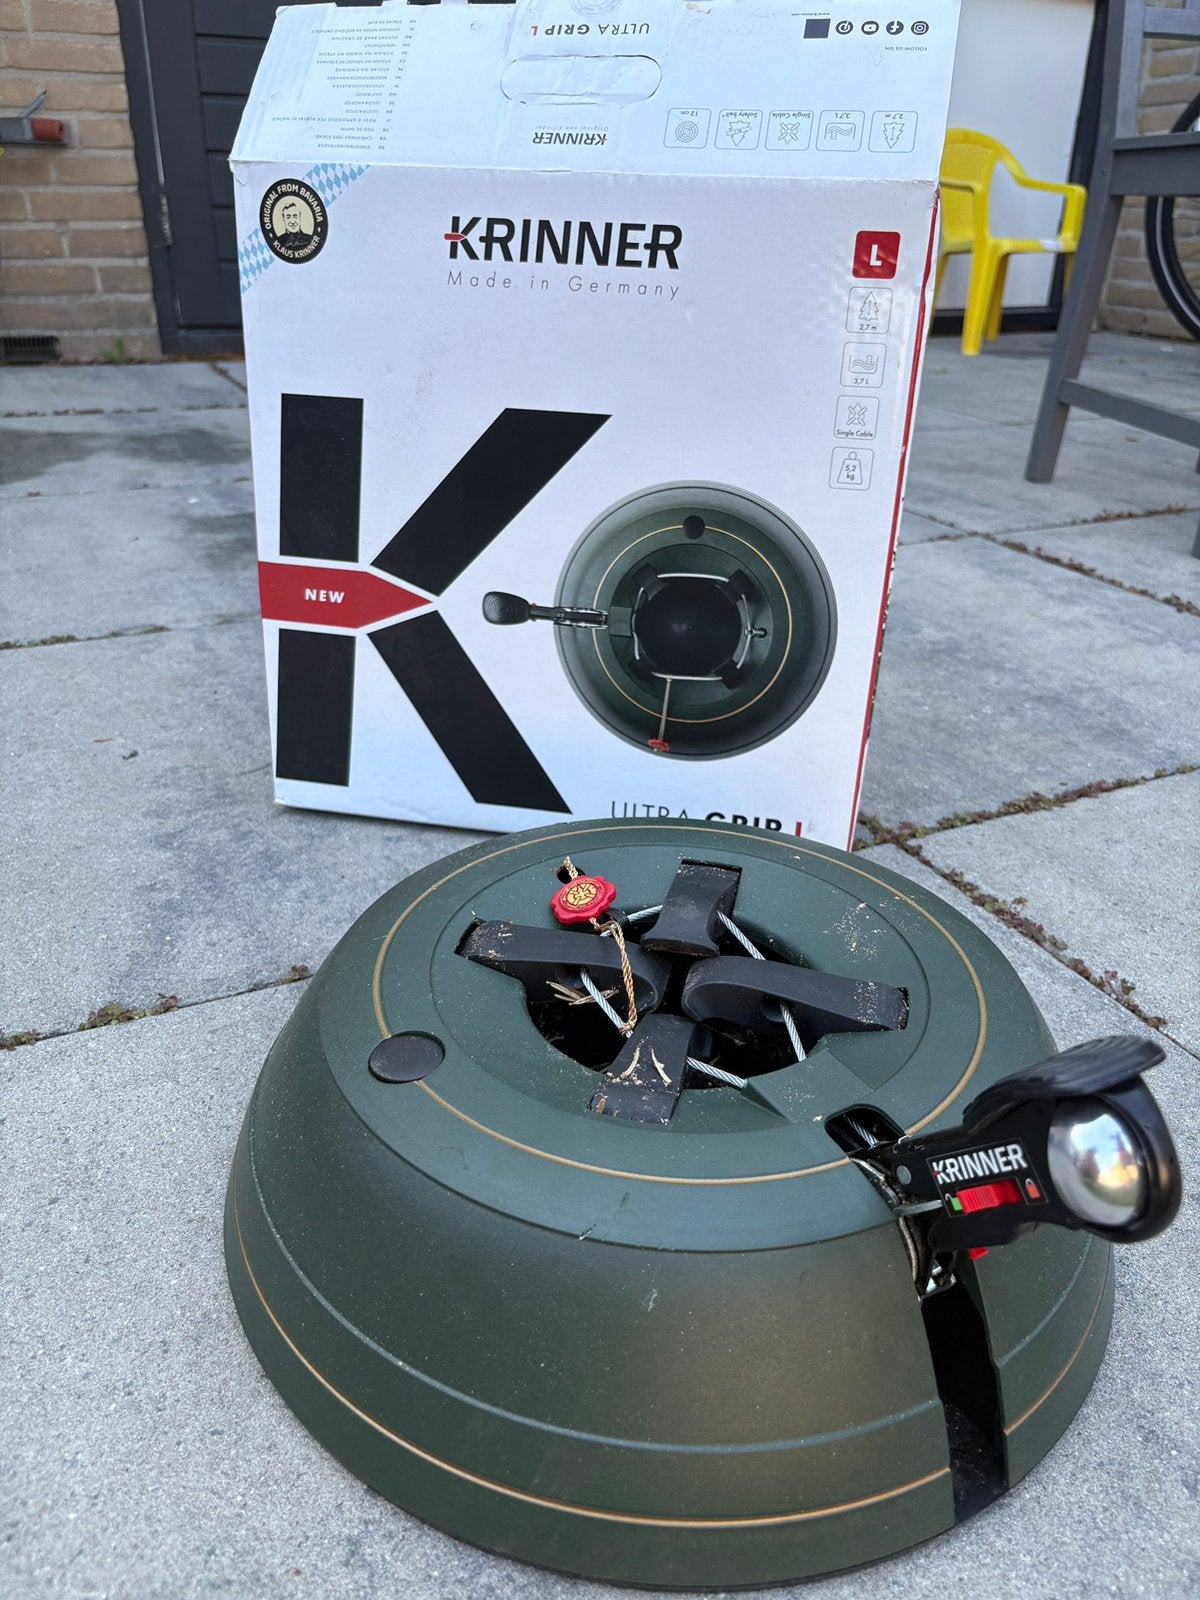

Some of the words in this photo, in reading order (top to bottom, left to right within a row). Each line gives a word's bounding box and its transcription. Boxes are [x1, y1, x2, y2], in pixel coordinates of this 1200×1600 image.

[531, 25, 538, 36] L
[544, 23, 590, 36] GRIP
[598, 23, 650, 35] ULTRA
[532, 132, 607, 145] KRINNER
[264, 190, 278, 230] ORIGINAL
[277, 184, 299, 194] FROM
[300, 188, 324, 222] BAVARIA
[273, 240, 294, 258] KLAUS
[294, 236, 320, 258] KRINNER
[444, 216, 682, 269] KRINNER
[870, 244, 882, 266] L
[447, 271, 512, 288] Made
[530, 276, 550, 290] in
[568, 276, 680, 300] Germany
[845, 464, 856, 472] 5,2
[846, 473, 854, 481] kg
[305, 588, 345, 604] NEW
[932, 1144, 1028, 1184] KRINNER
